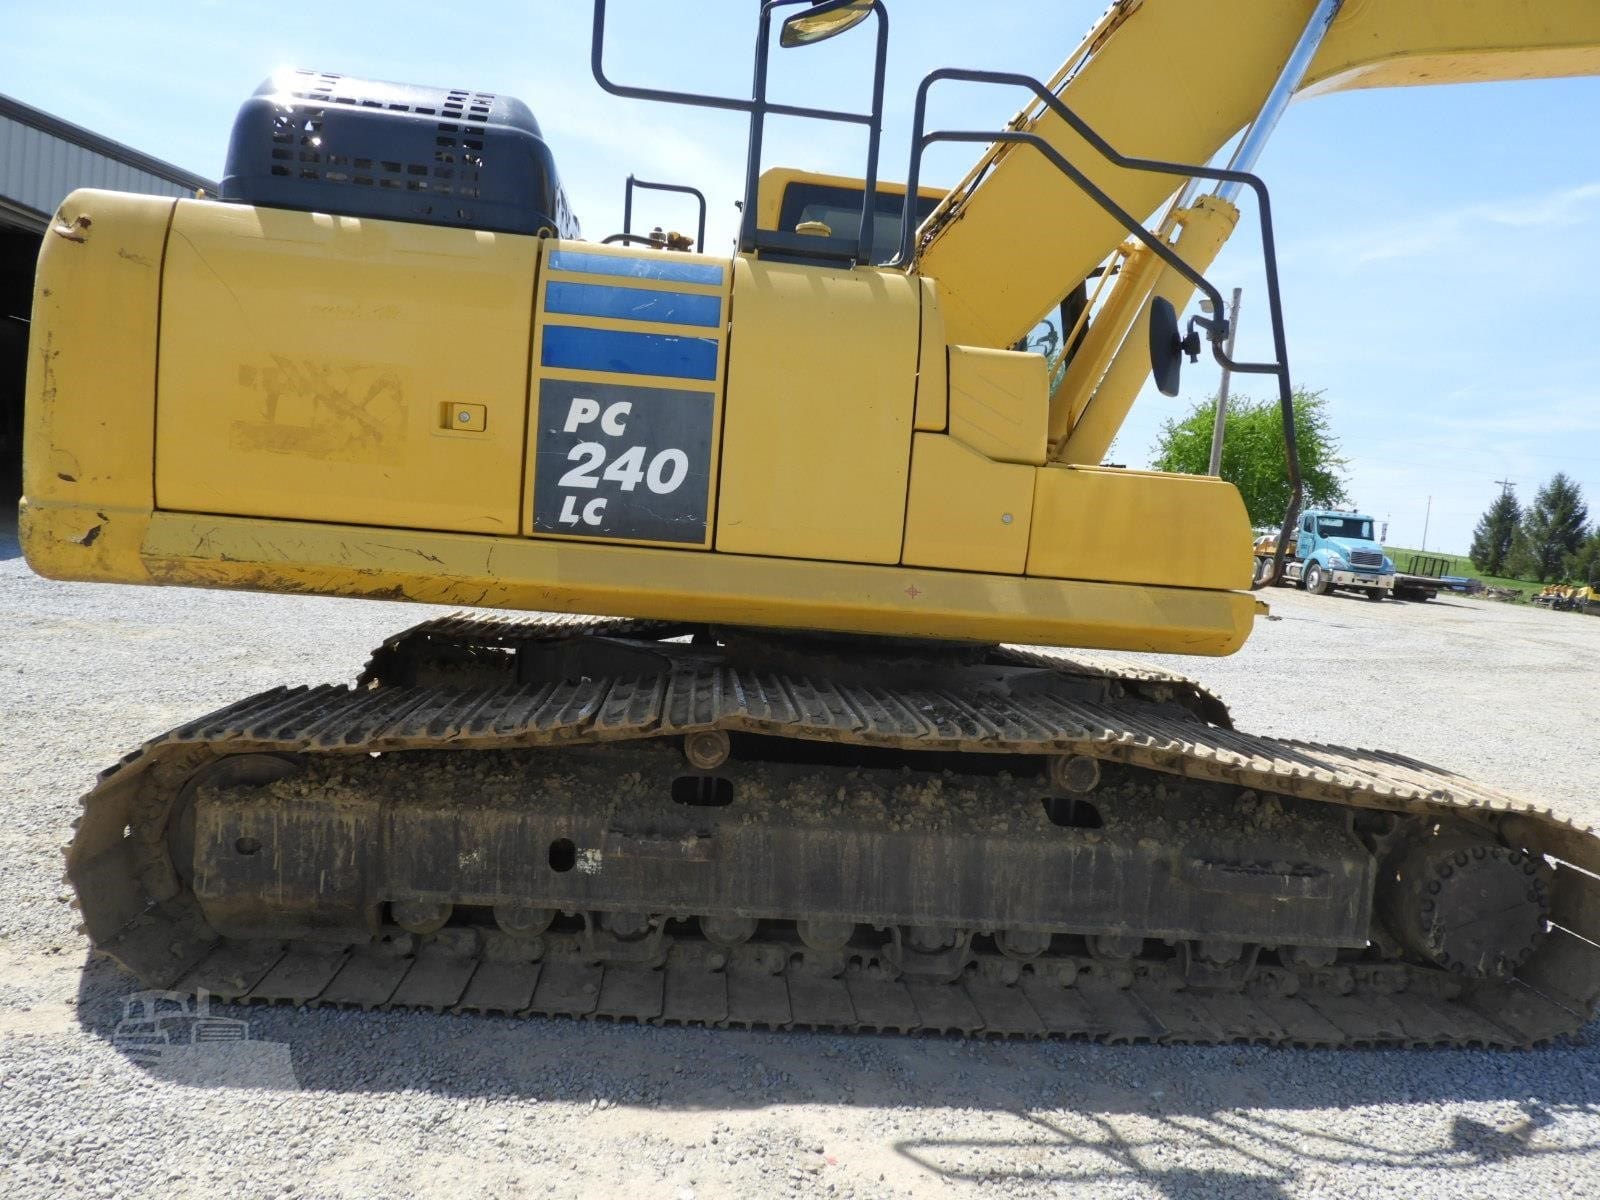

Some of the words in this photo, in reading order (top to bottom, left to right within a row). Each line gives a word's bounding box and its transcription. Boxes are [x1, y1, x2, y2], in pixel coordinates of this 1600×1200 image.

[563, 398, 633, 437] PC
[557, 442, 689, 494] 240
[559, 495, 608, 526] LC
